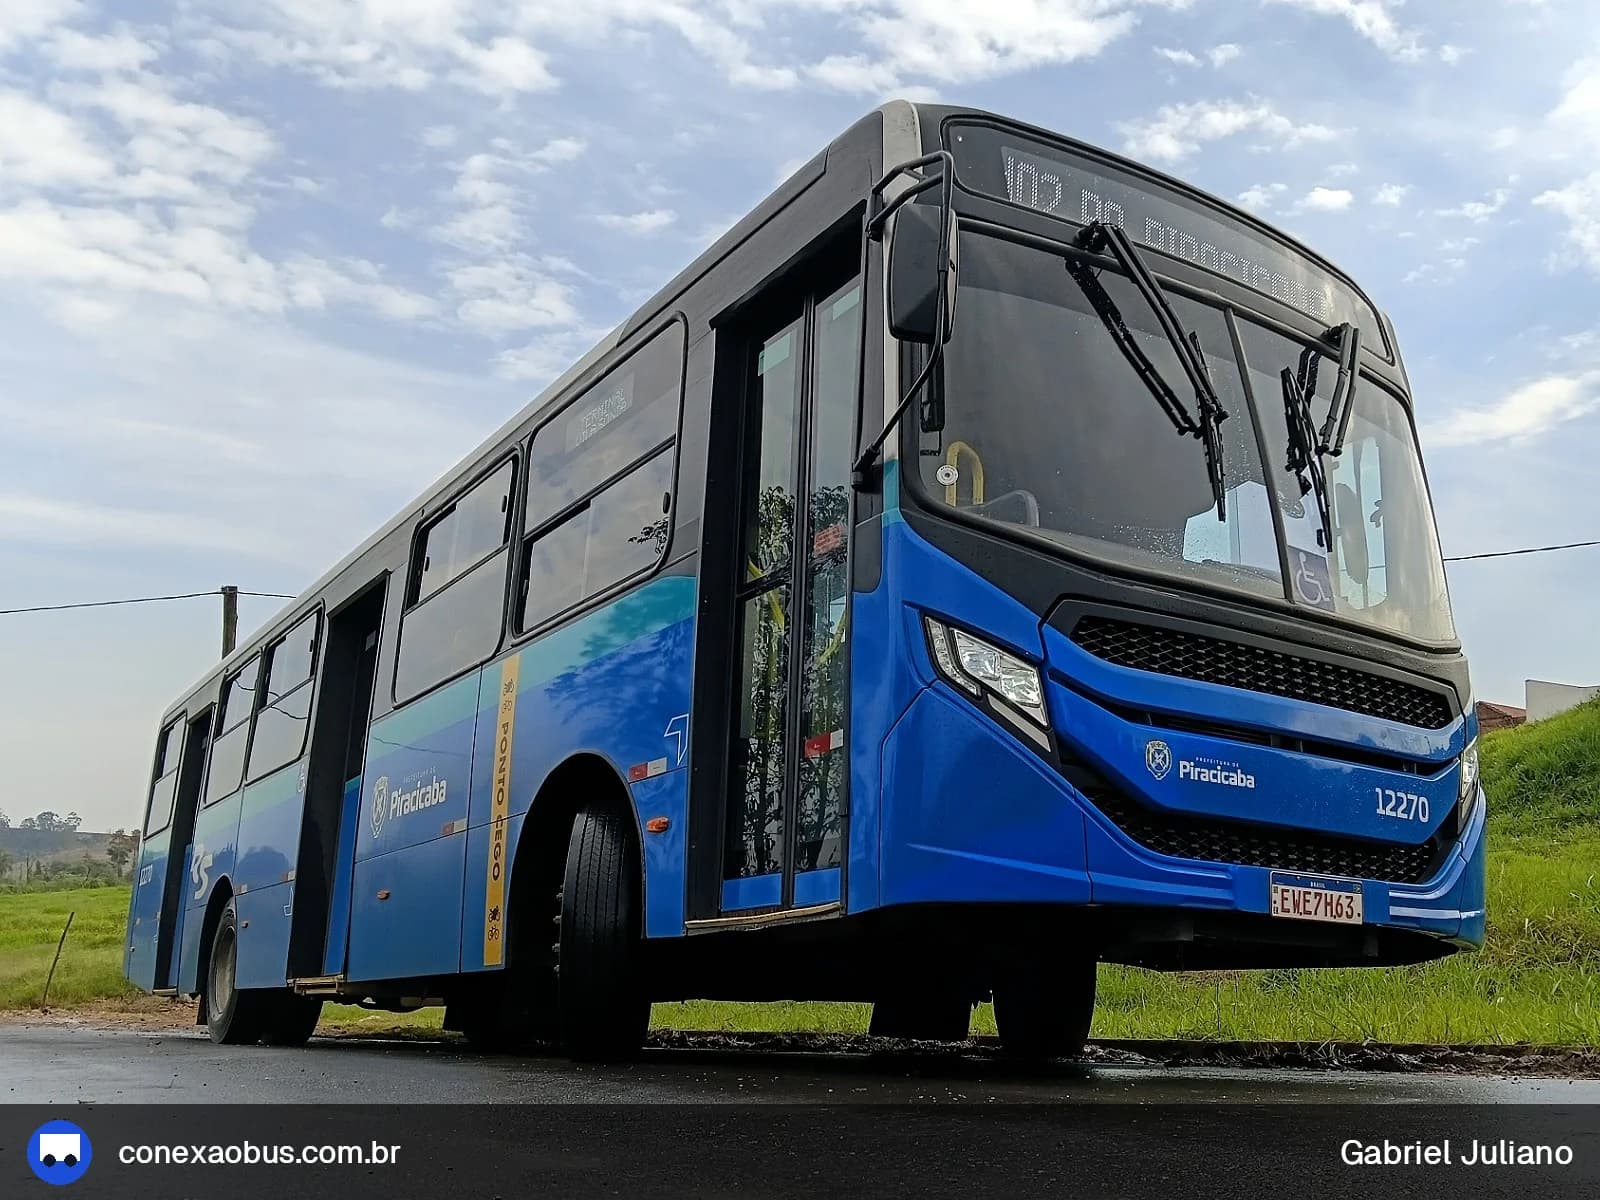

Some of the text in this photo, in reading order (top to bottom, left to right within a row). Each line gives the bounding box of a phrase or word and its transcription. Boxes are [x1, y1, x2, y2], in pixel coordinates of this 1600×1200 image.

[1179, 760, 1255, 789] Piracicaba
[389, 775, 446, 820] Piracicaba
[492, 721, 509, 881] PONTO CEGO
[1375, 787, 1429, 823] 12270
[1280, 888, 1354, 919] EWE7H63
